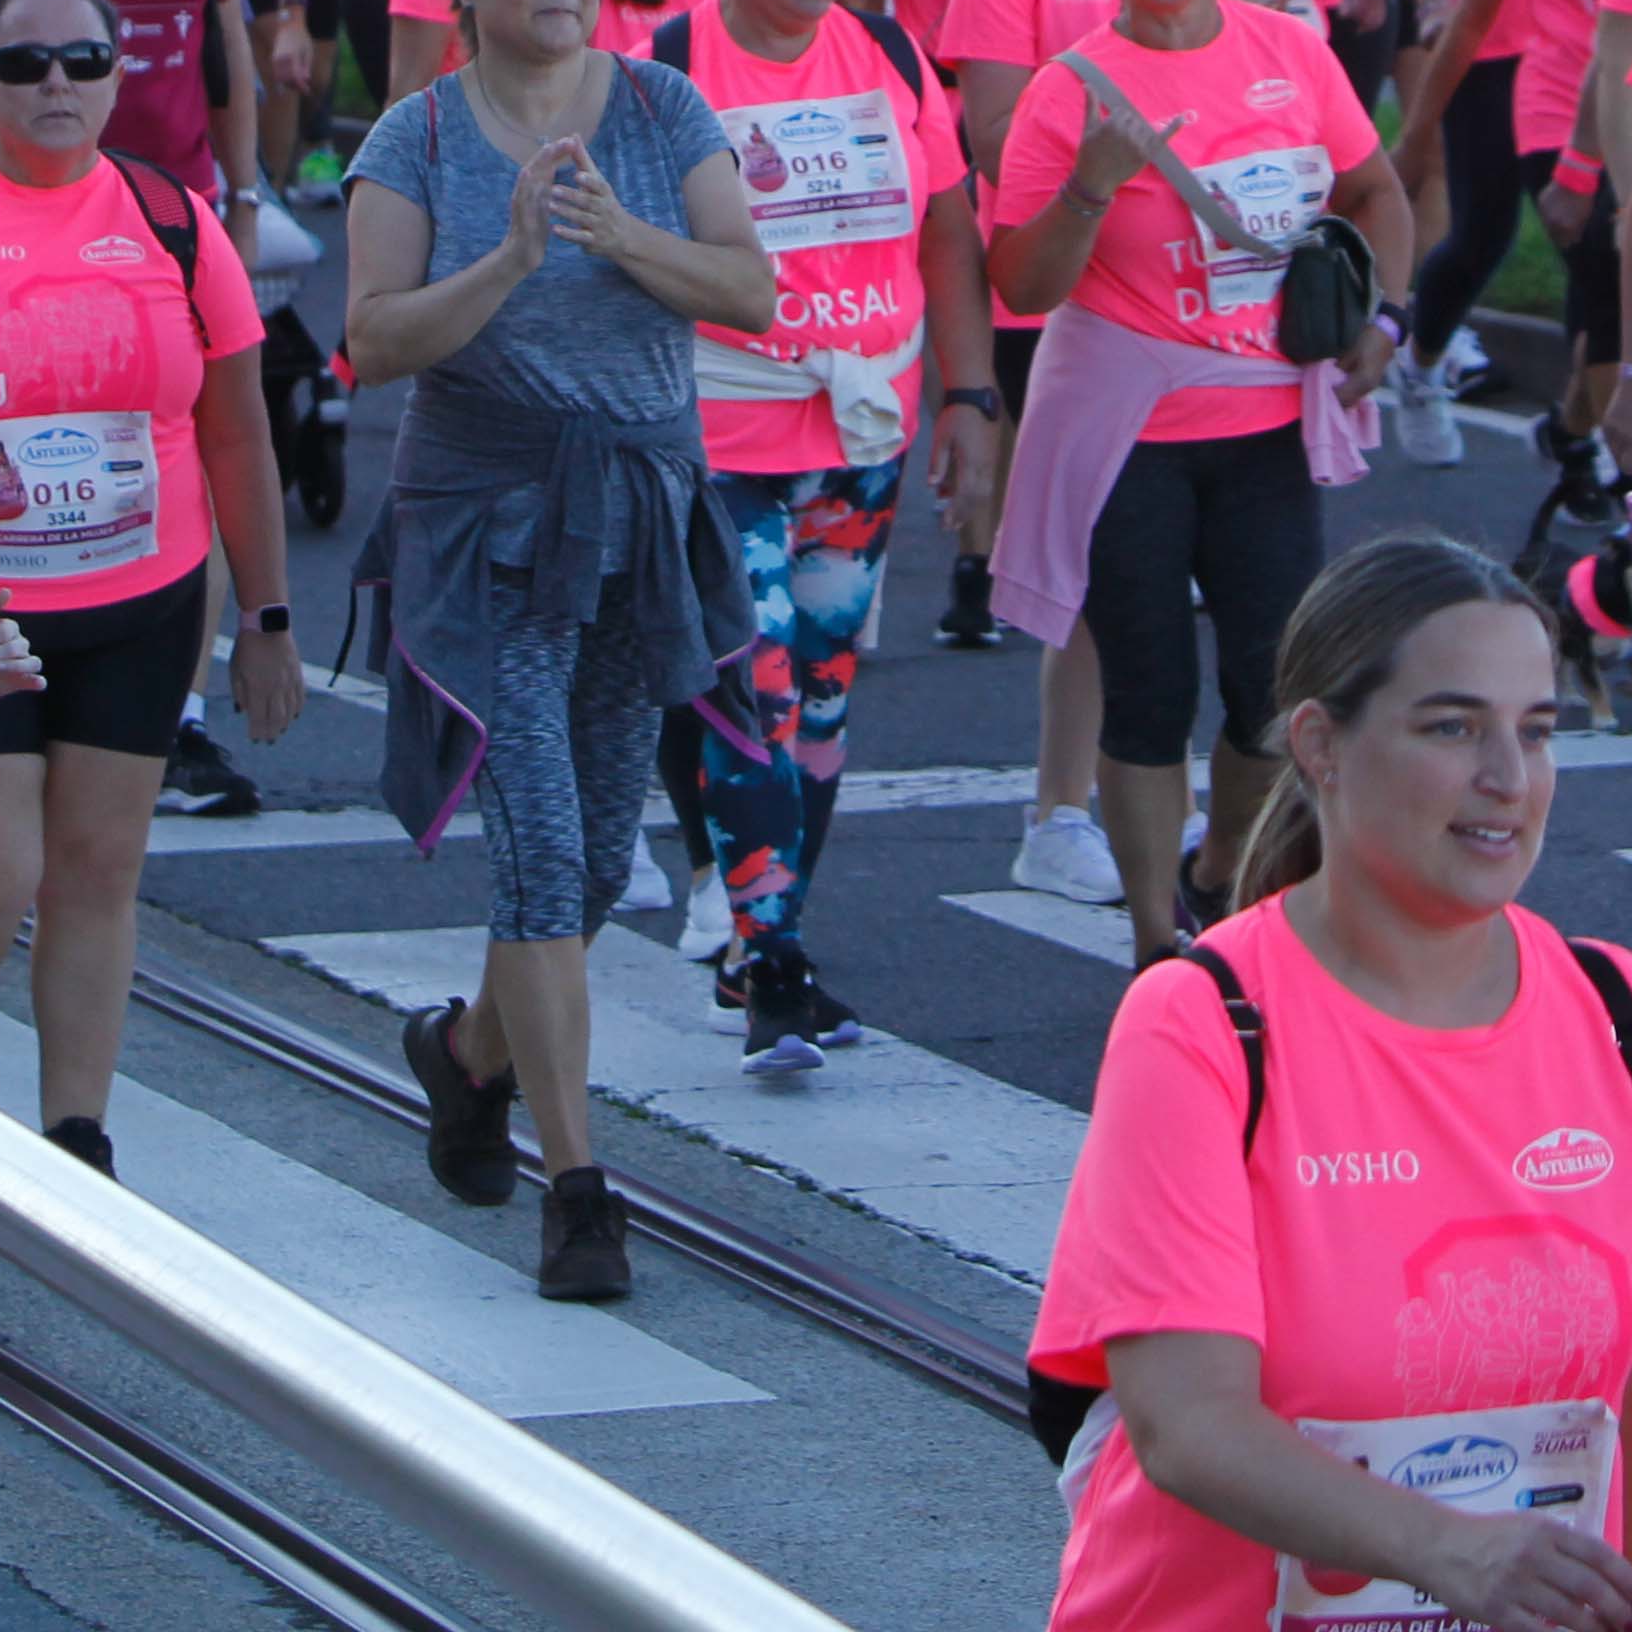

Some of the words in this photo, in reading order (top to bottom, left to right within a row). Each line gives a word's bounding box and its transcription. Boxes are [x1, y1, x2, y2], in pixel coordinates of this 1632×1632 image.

[791, 151, 848, 177] 016
[1248, 210, 1292, 235] 016
[774, 279, 900, 328] ORSAL
[25, 443, 94, 460] ASTURIANA
[33, 478, 96, 506] 016
[47, 510, 87, 526] 3344
[1296, 1149, 1421, 1186] OYSHO
[1523, 1151, 1609, 1180] ASTURIANA
[1531, 1436, 1589, 1456] SUMA
[1401, 1459, 1506, 1491] ASTURIANA
